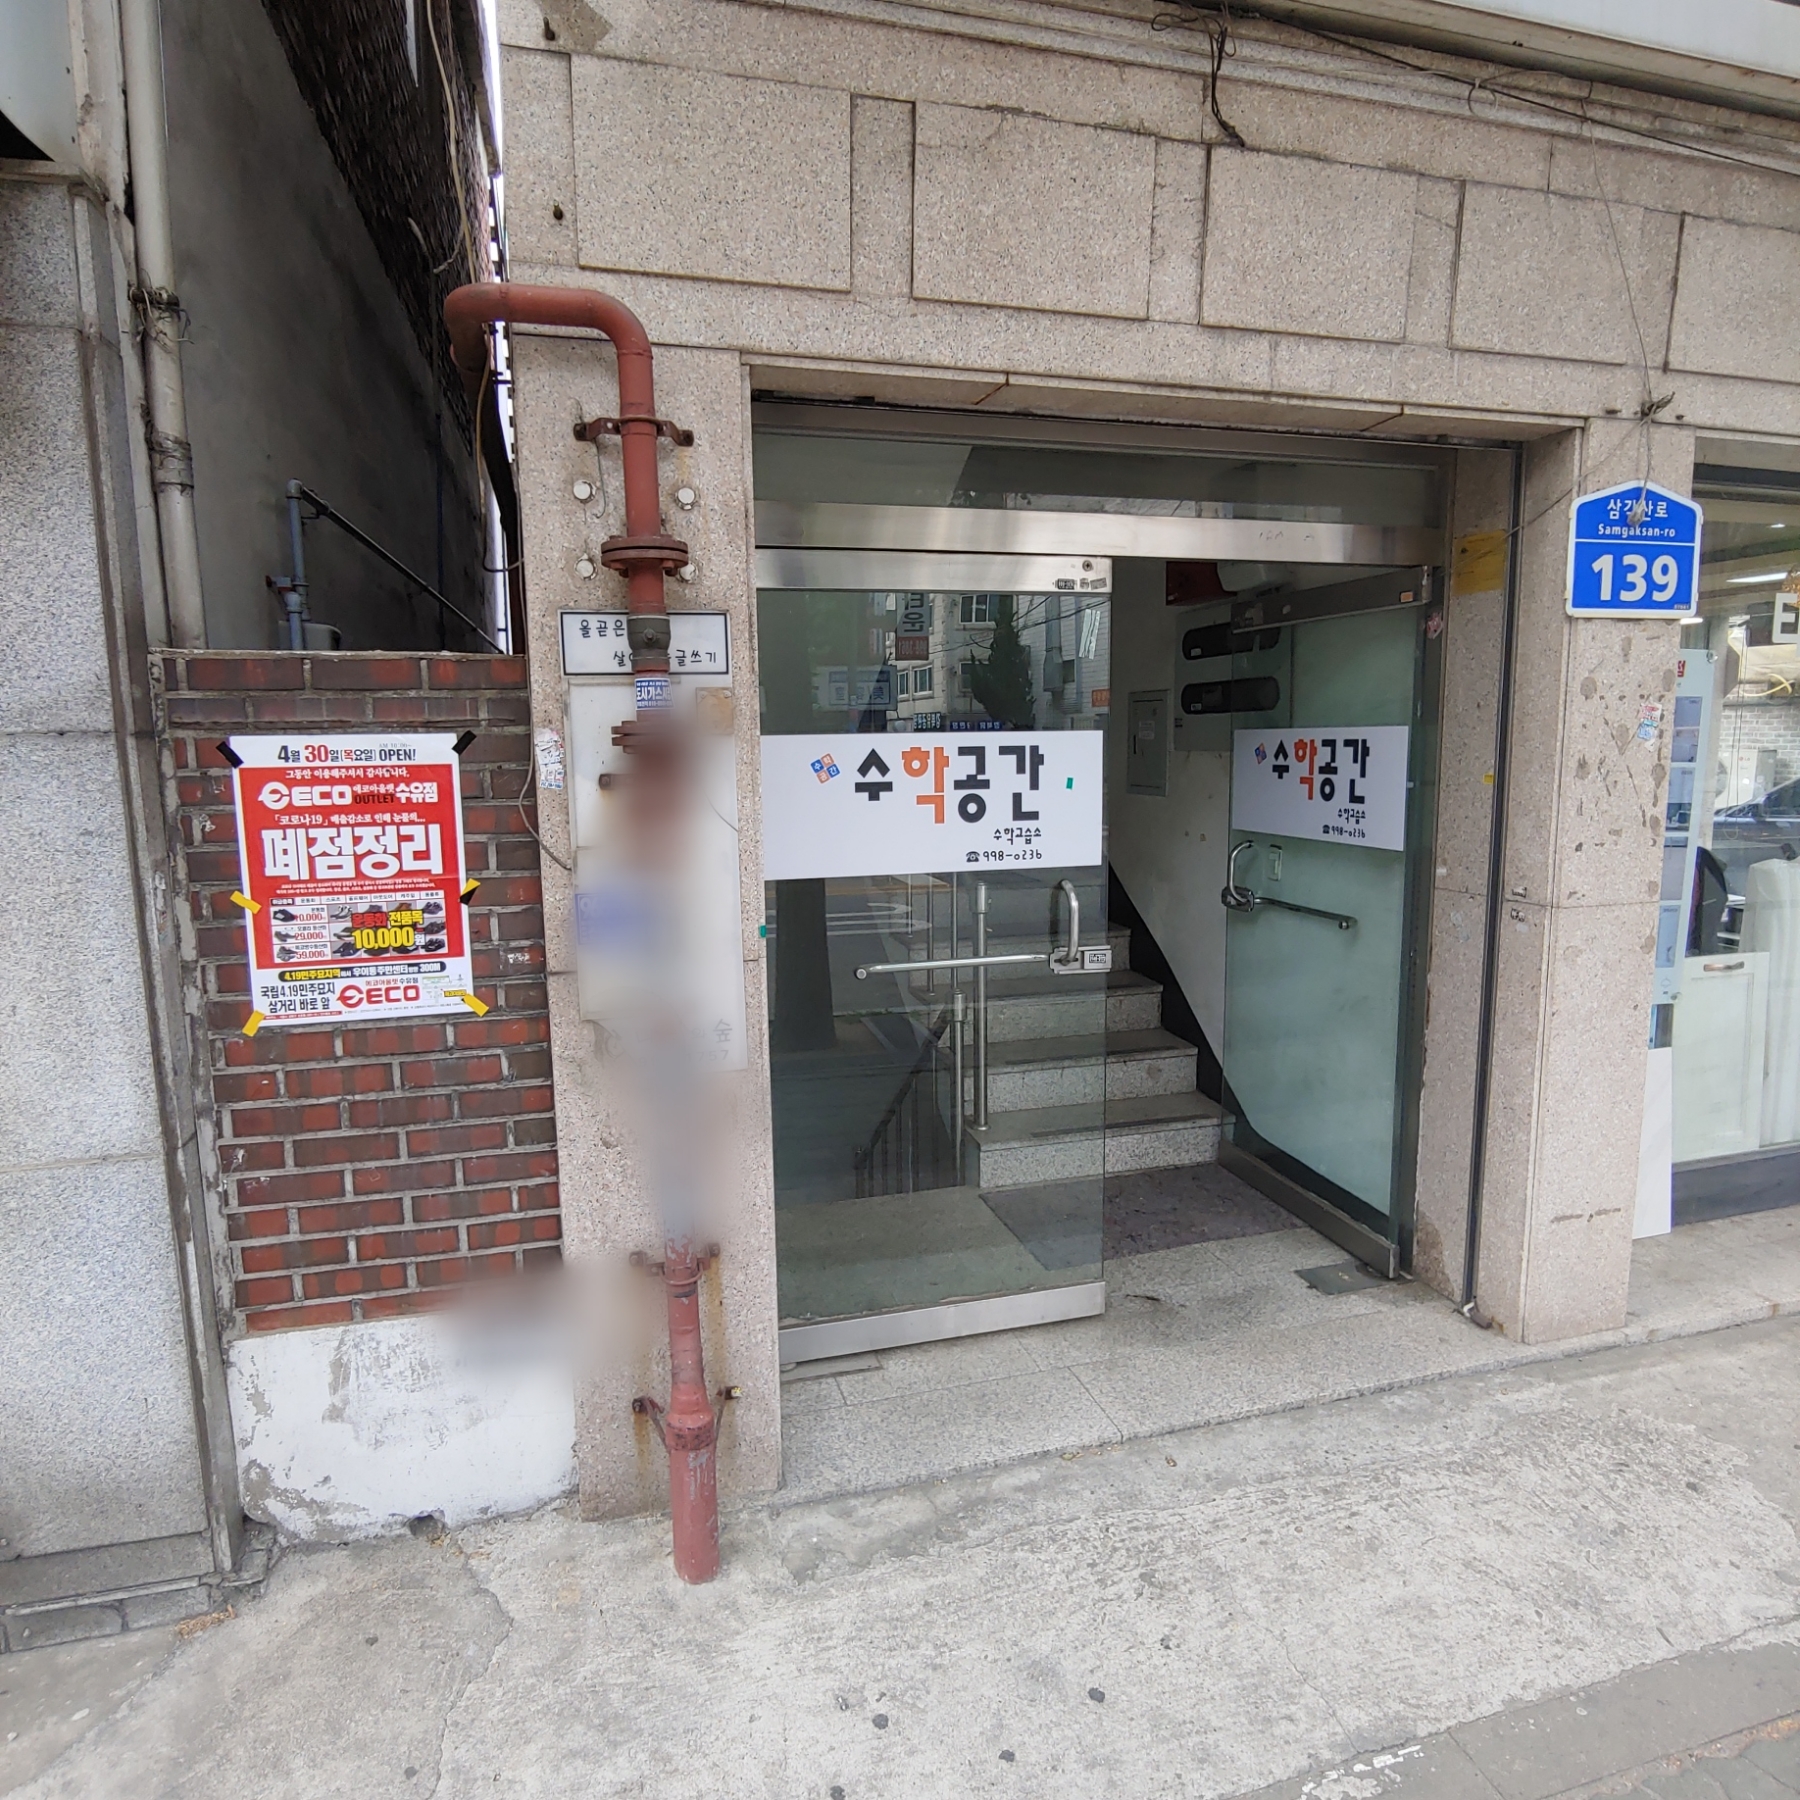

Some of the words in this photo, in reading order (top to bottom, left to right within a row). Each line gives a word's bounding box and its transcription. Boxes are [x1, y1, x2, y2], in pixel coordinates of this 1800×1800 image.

[1598, 523, 1676, 538] Samgaksan-ro
[1591, 554, 1679, 602] 139
[277, 744, 300, 763] 4월
[379, 748, 416, 762] OPEN!
[285, 769, 311, 780] 그동안
[1272, 739, 1370, 804] 수학공간
[353, 783, 395, 794] 에코아울렛
[395, 782, 438, 804] 수유점
[855, 745, 1044, 824] 수학공간
[291, 784, 352, 807] ECO
[354, 794, 395, 804] OUTLET
[374, 812, 391, 823] 인해
[993, 827, 1042, 845] 수학교습소
[261, 825, 443, 880] 폐점정리
[982, 850, 1043, 862] 998-0236
[351, 912, 387, 928] 운동화
[388, 910, 423, 926] 전품목
[365, 985, 420, 1005] ECO
[268, 1000, 296, 1013] 삼거리
[299, 1000, 317, 1012] 바로
[320, 997, 330, 1010] 앞
